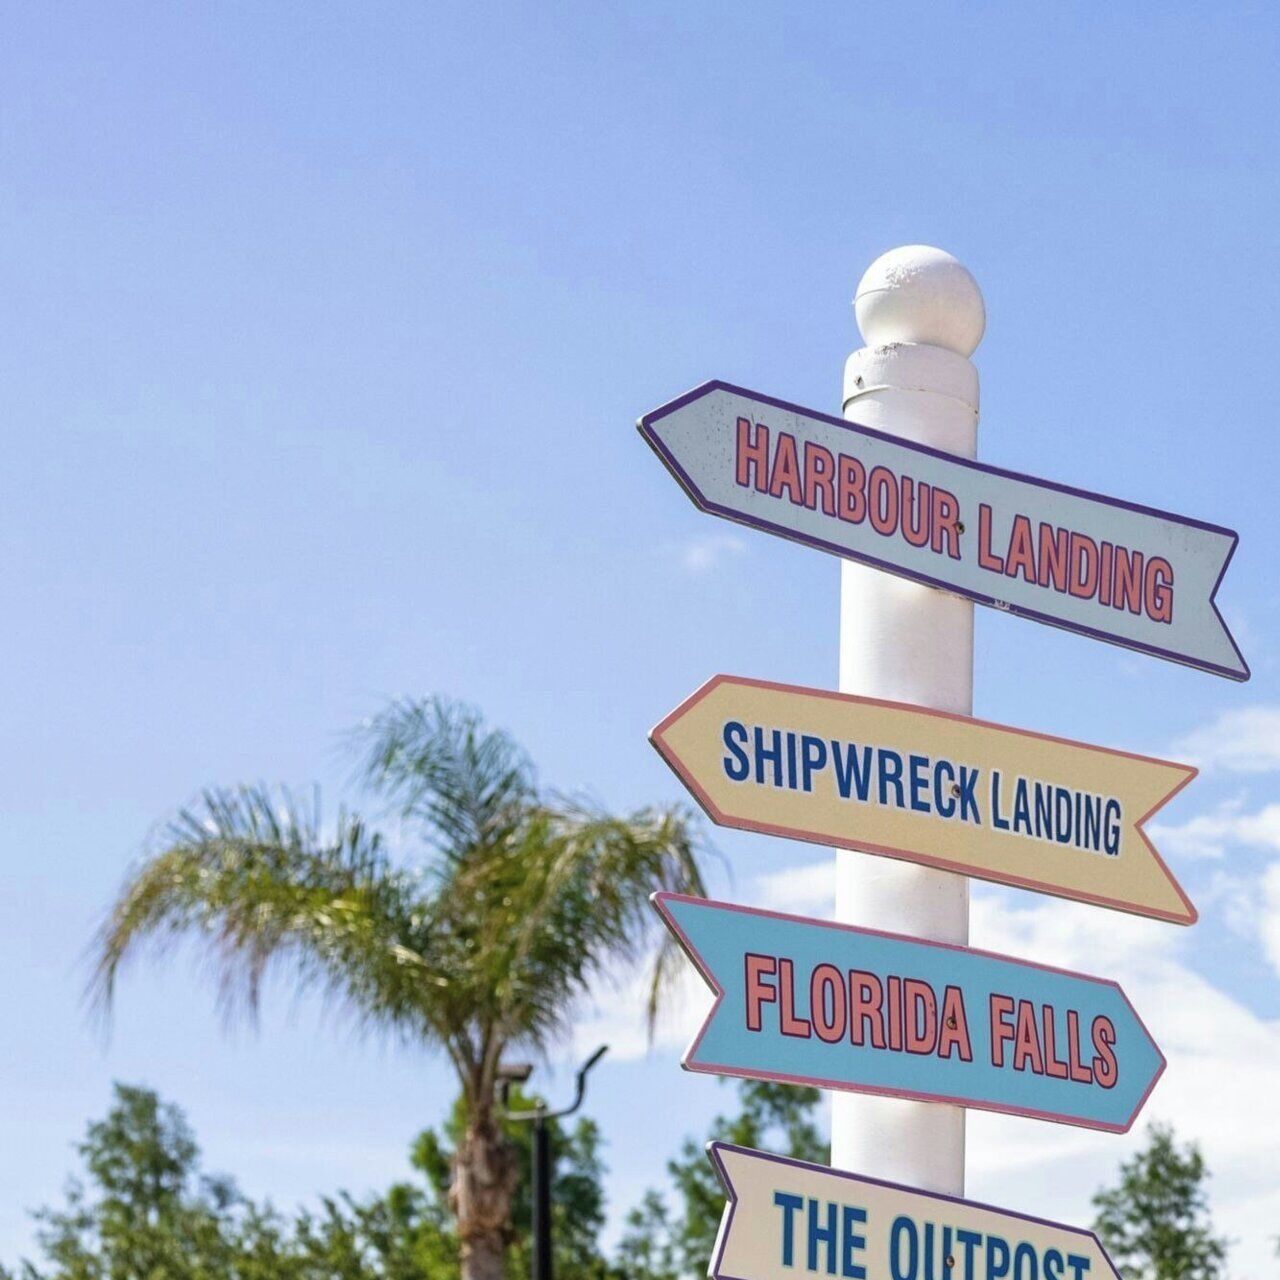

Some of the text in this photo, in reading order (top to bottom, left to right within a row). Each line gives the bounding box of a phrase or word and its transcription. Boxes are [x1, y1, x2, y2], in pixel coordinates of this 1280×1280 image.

[734, 416, 1174, 624] HARBOUR LANDING
[722, 720, 1121, 855] SHIPWRECK LANDING
[744, 952, 1118, 1089] FLORIDA FALLS
[773, 1191, 867, 1280] THE
